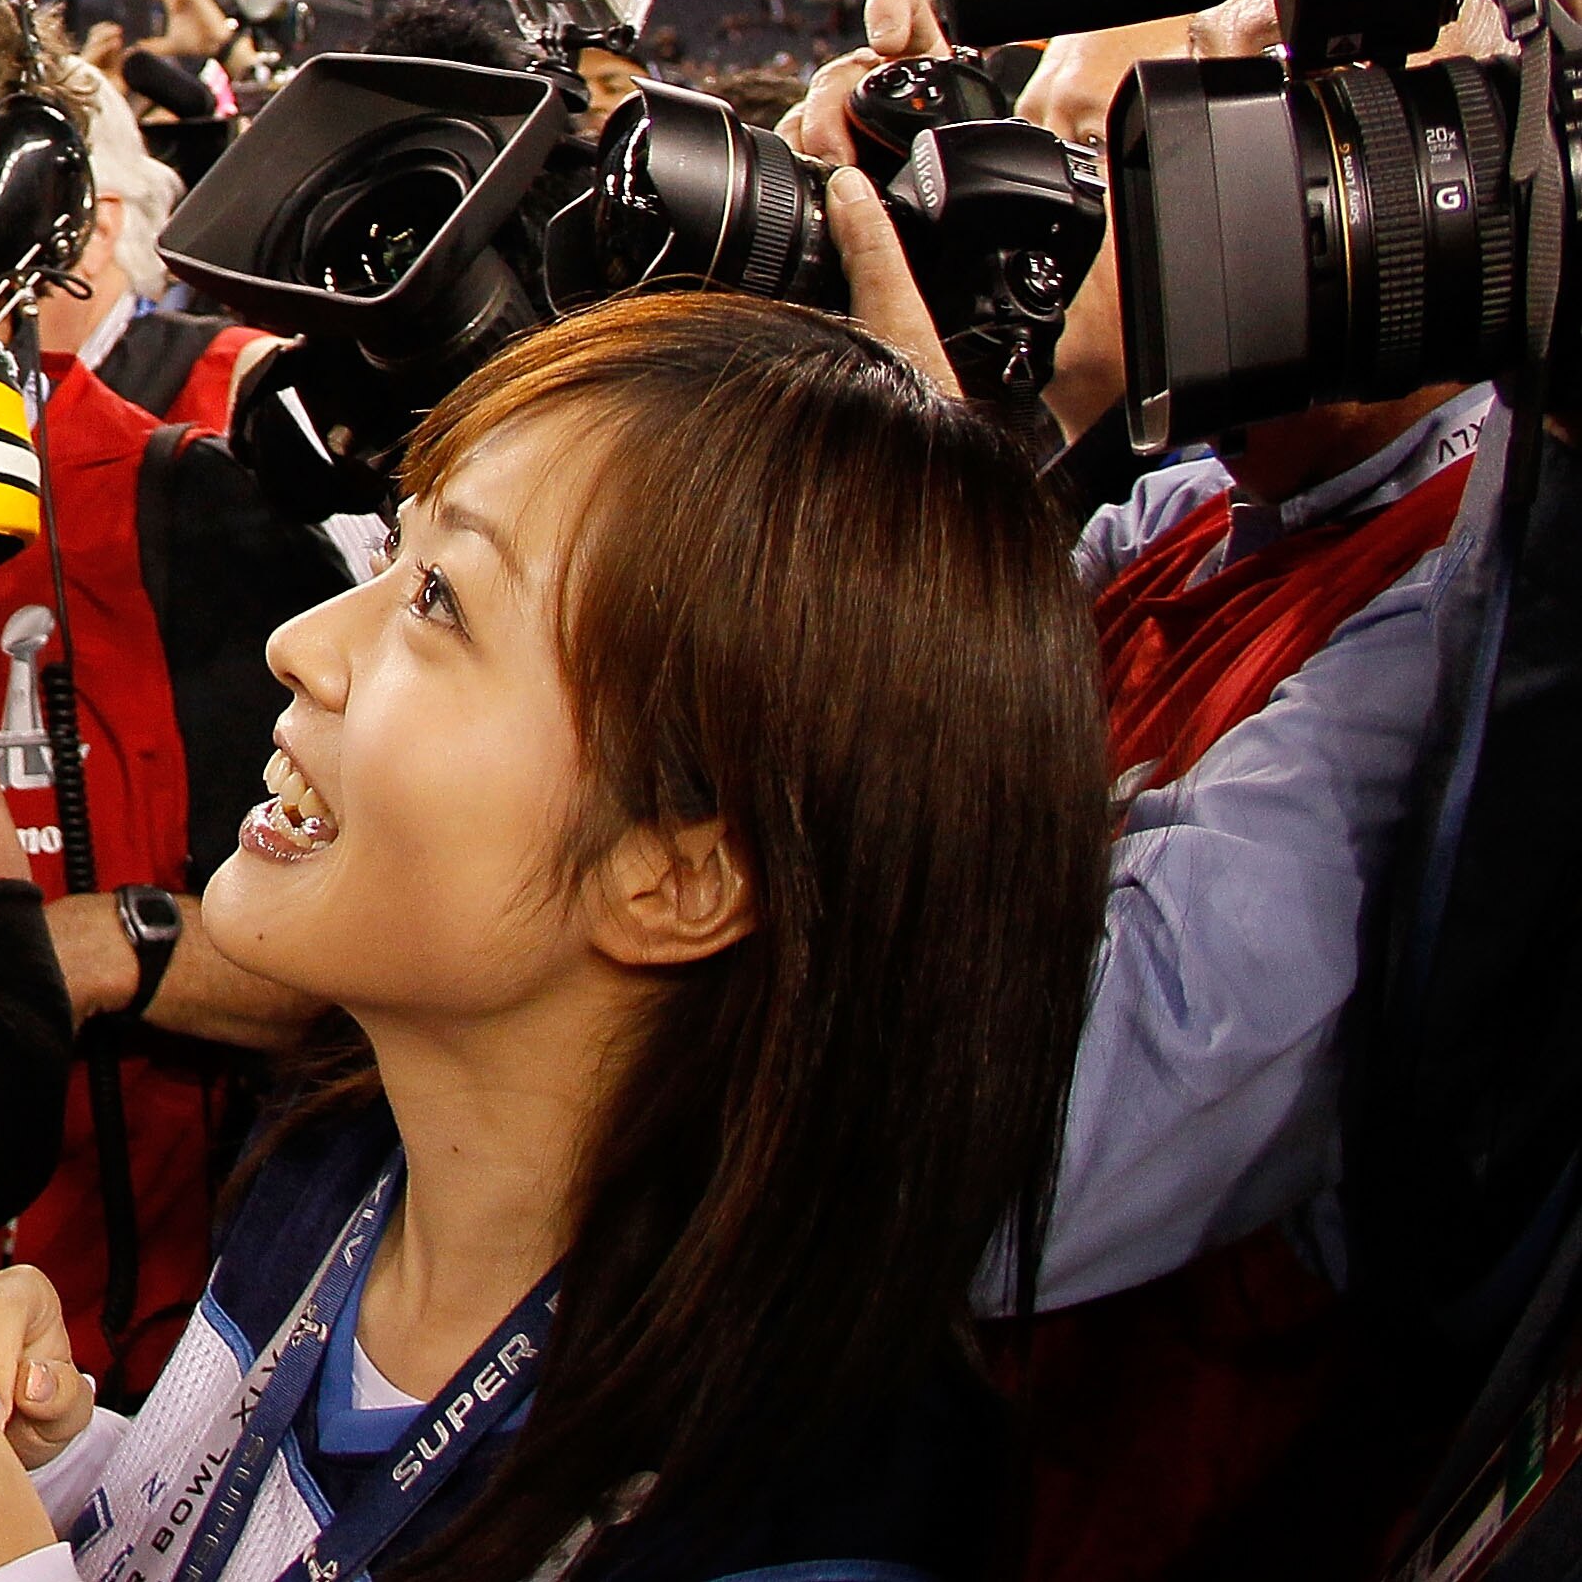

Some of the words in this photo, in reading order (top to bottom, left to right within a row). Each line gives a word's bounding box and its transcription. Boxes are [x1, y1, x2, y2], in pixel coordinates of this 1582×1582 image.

[1424, 126, 1457, 145] 20x
[914, 142, 938, 208] Nikon
[1342, 154, 1356, 187] Lens
[1348, 189, 1361, 225] Sony
[1435, 185, 1462, 210] G
[392, 1333, 538, 1491] SUPER
[151, 1447, 231, 1554] BOWL
